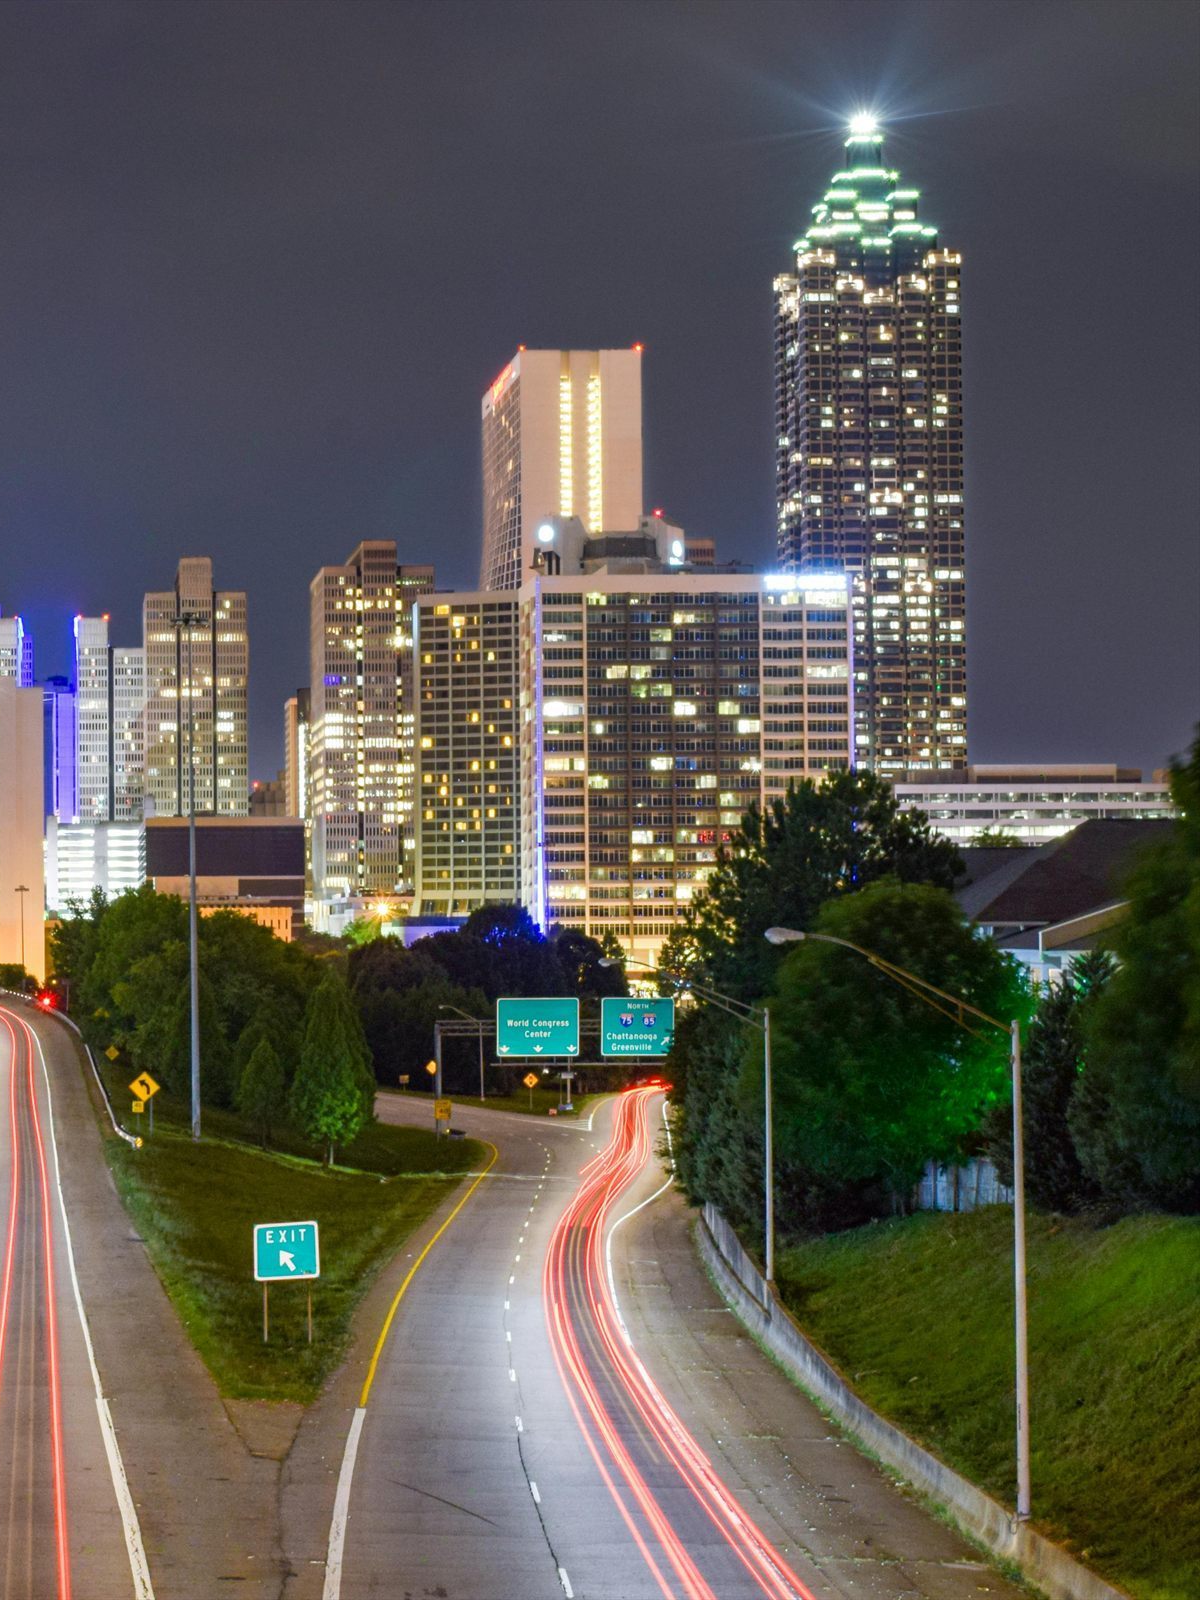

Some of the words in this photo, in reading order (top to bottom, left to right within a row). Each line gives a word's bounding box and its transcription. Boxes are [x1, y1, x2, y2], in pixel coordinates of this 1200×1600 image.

[507, 1019, 529, 1027] World
[532, 1019, 570, 1029] Congress
[622, 1017, 632, 1025] 75
[643, 1017, 655, 1025] 85
[524, 1030, 551, 1038] Center
[606, 1032, 658, 1042] Chattanooga
[611, 1043, 652, 1051] Greenville
[266, 1229, 306, 1244] EXIT
